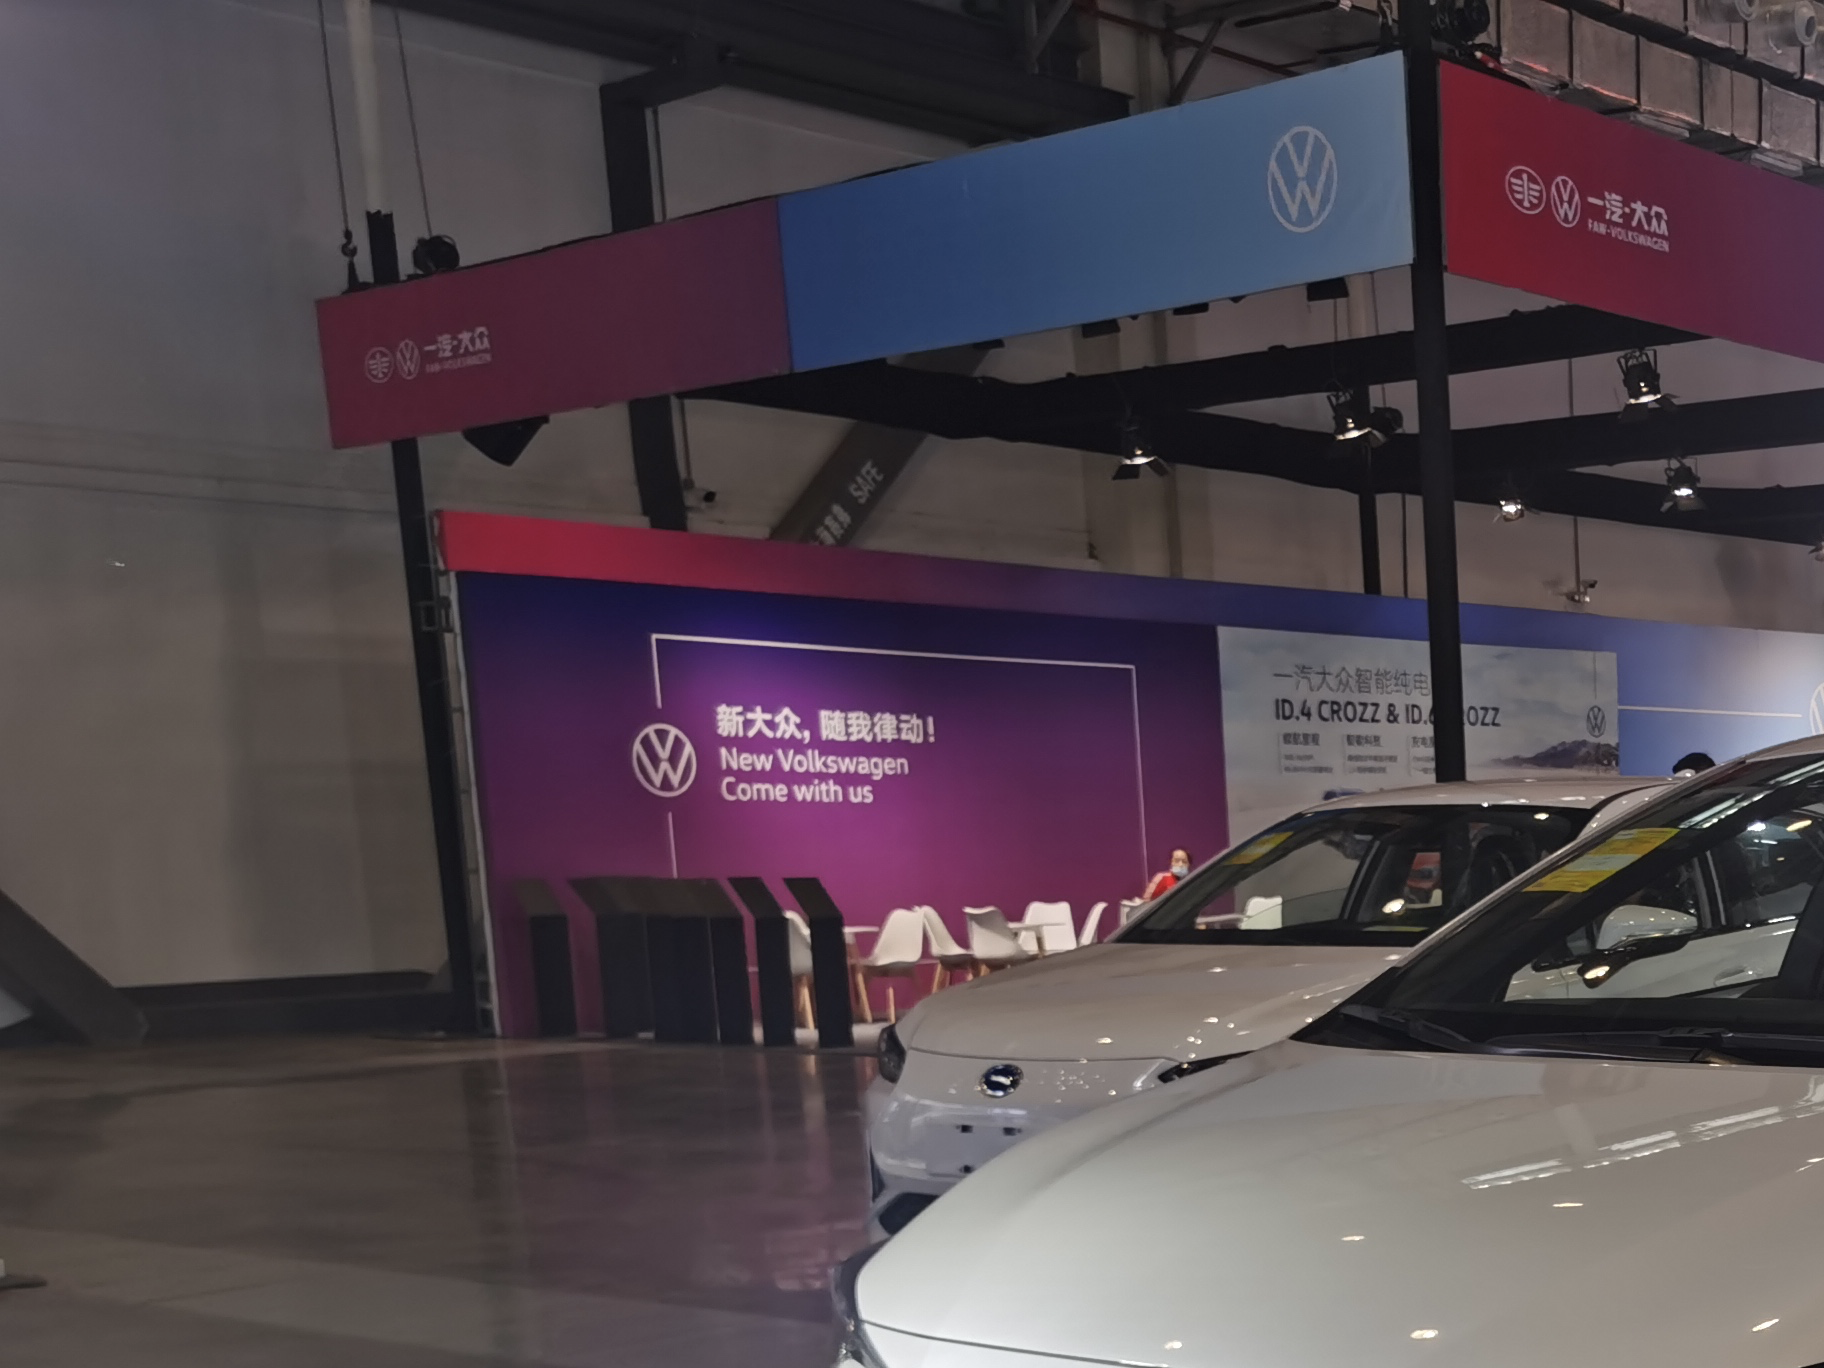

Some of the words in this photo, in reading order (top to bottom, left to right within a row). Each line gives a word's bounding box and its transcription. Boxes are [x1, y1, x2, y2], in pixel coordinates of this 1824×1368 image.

[1587, 218, 1670, 253] FAW-VOLKSWAGEN
[848, 459, 885, 505] SAFE
[1275, 698, 1312, 722] ID.4
[1317, 699, 1382, 724] CROZZ
[1386, 702, 1401, 725] &
[719, 746, 773, 772] New
[775, 748, 909, 780] Volkswagen
[720, 776, 788, 801] Come
[793, 778, 843, 802] with
[848, 783, 874, 803] us
